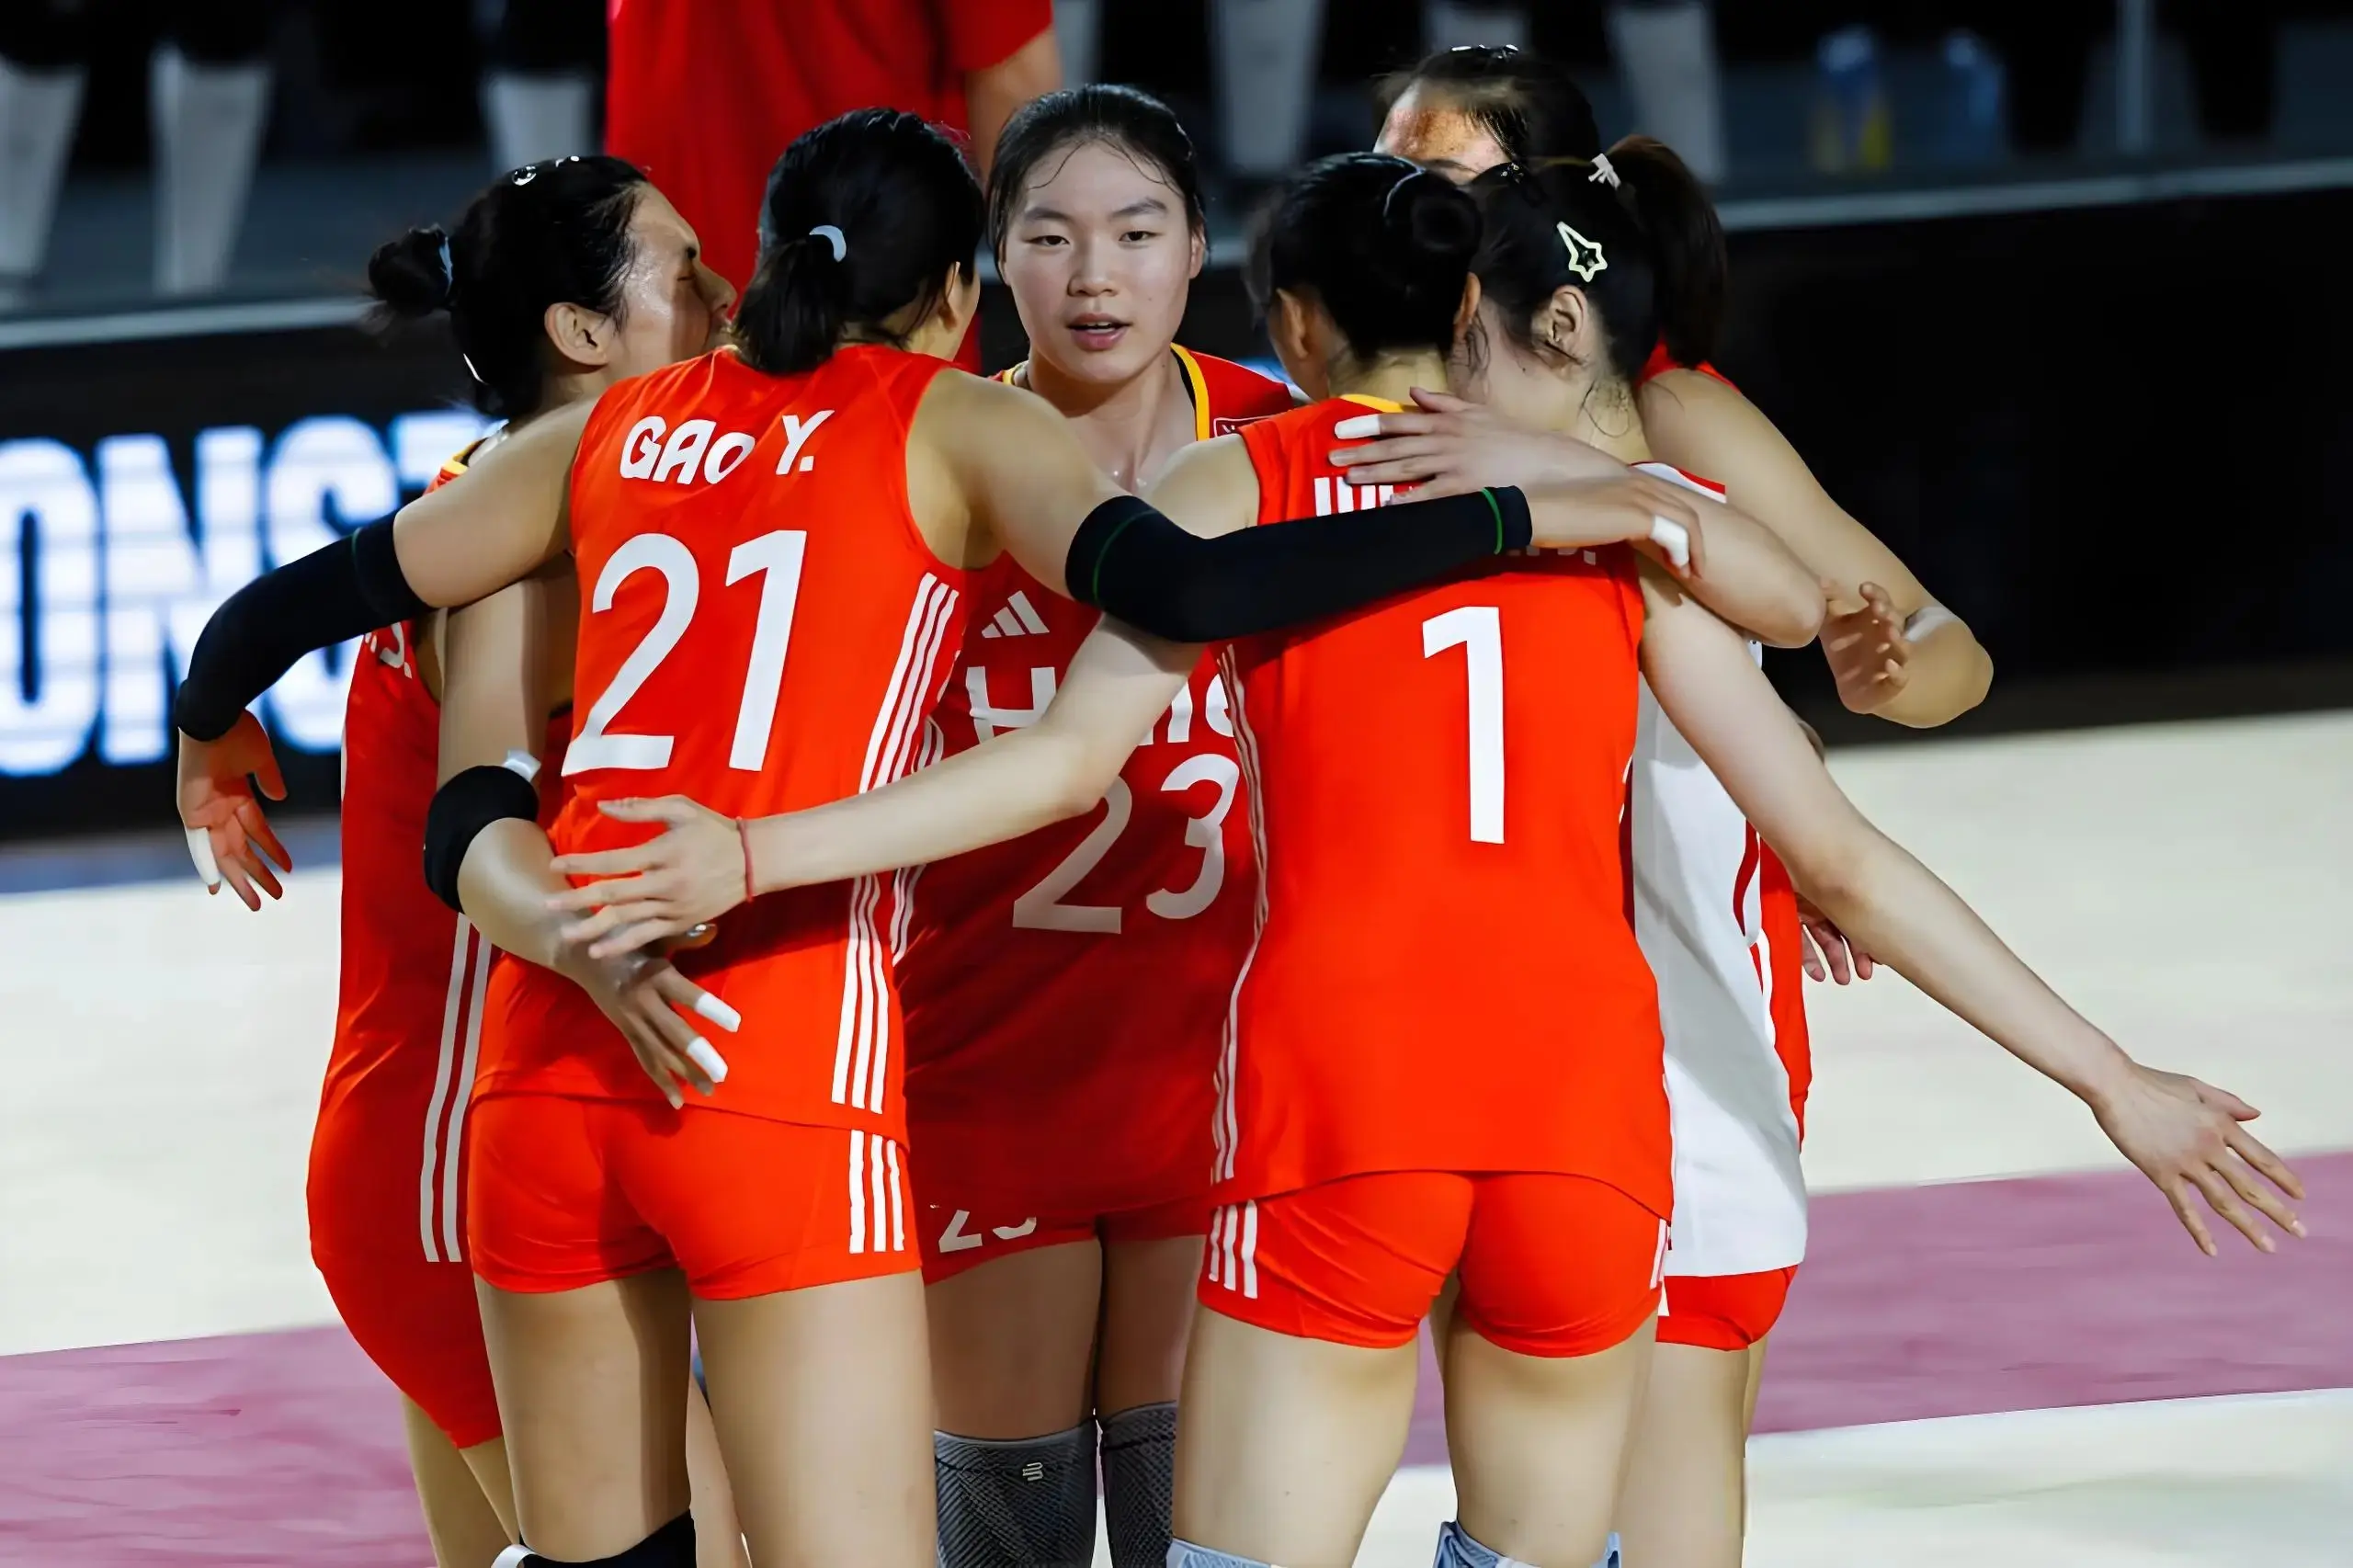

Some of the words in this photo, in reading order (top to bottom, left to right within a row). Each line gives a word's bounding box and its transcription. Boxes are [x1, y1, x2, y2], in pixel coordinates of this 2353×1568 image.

[620, 415, 756, 485] GAO
[775, 410, 835, 476] Y.
[0, 412, 484, 778] ONS
[561, 529, 807, 778] 21
[1012, 753, 1240, 935] 23
[1422, 606, 1505, 845] 1
